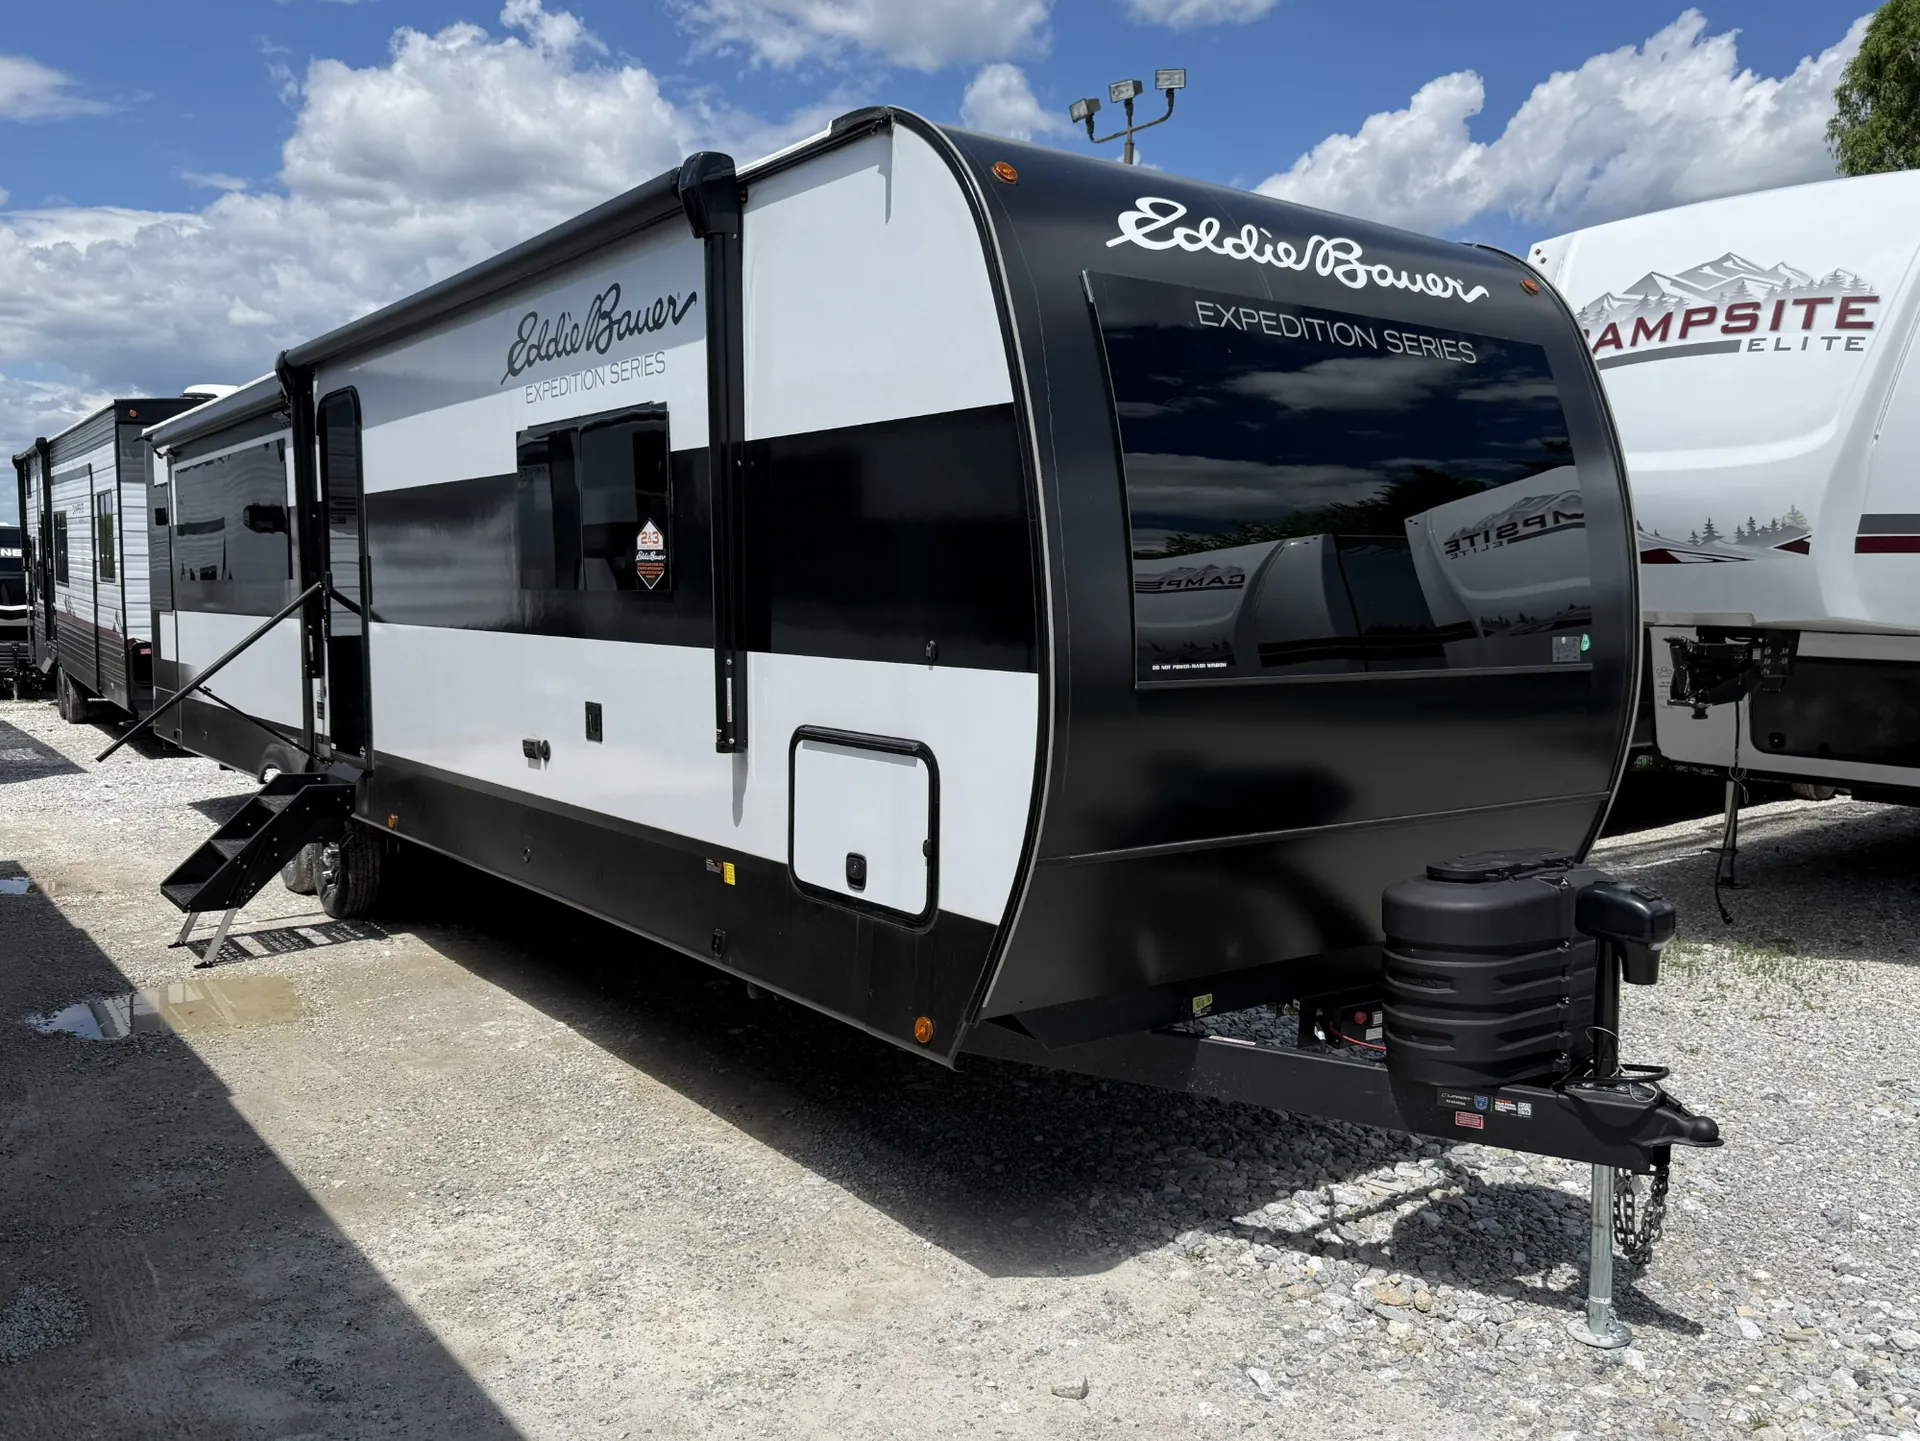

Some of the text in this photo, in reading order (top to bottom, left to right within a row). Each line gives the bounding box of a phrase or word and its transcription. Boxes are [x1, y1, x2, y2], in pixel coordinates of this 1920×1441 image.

[1106, 197, 1489, 302] Eddie Bauer
[500, 283, 697, 385] Eddie Bauer
[1195, 300, 1477, 364] EXPEDITION SERIES
[1583, 295, 1880, 355] AMPSITE
[1747, 336, 1866, 352] ELITE
[525, 351, 666, 404] EXPEDITION SERIES
